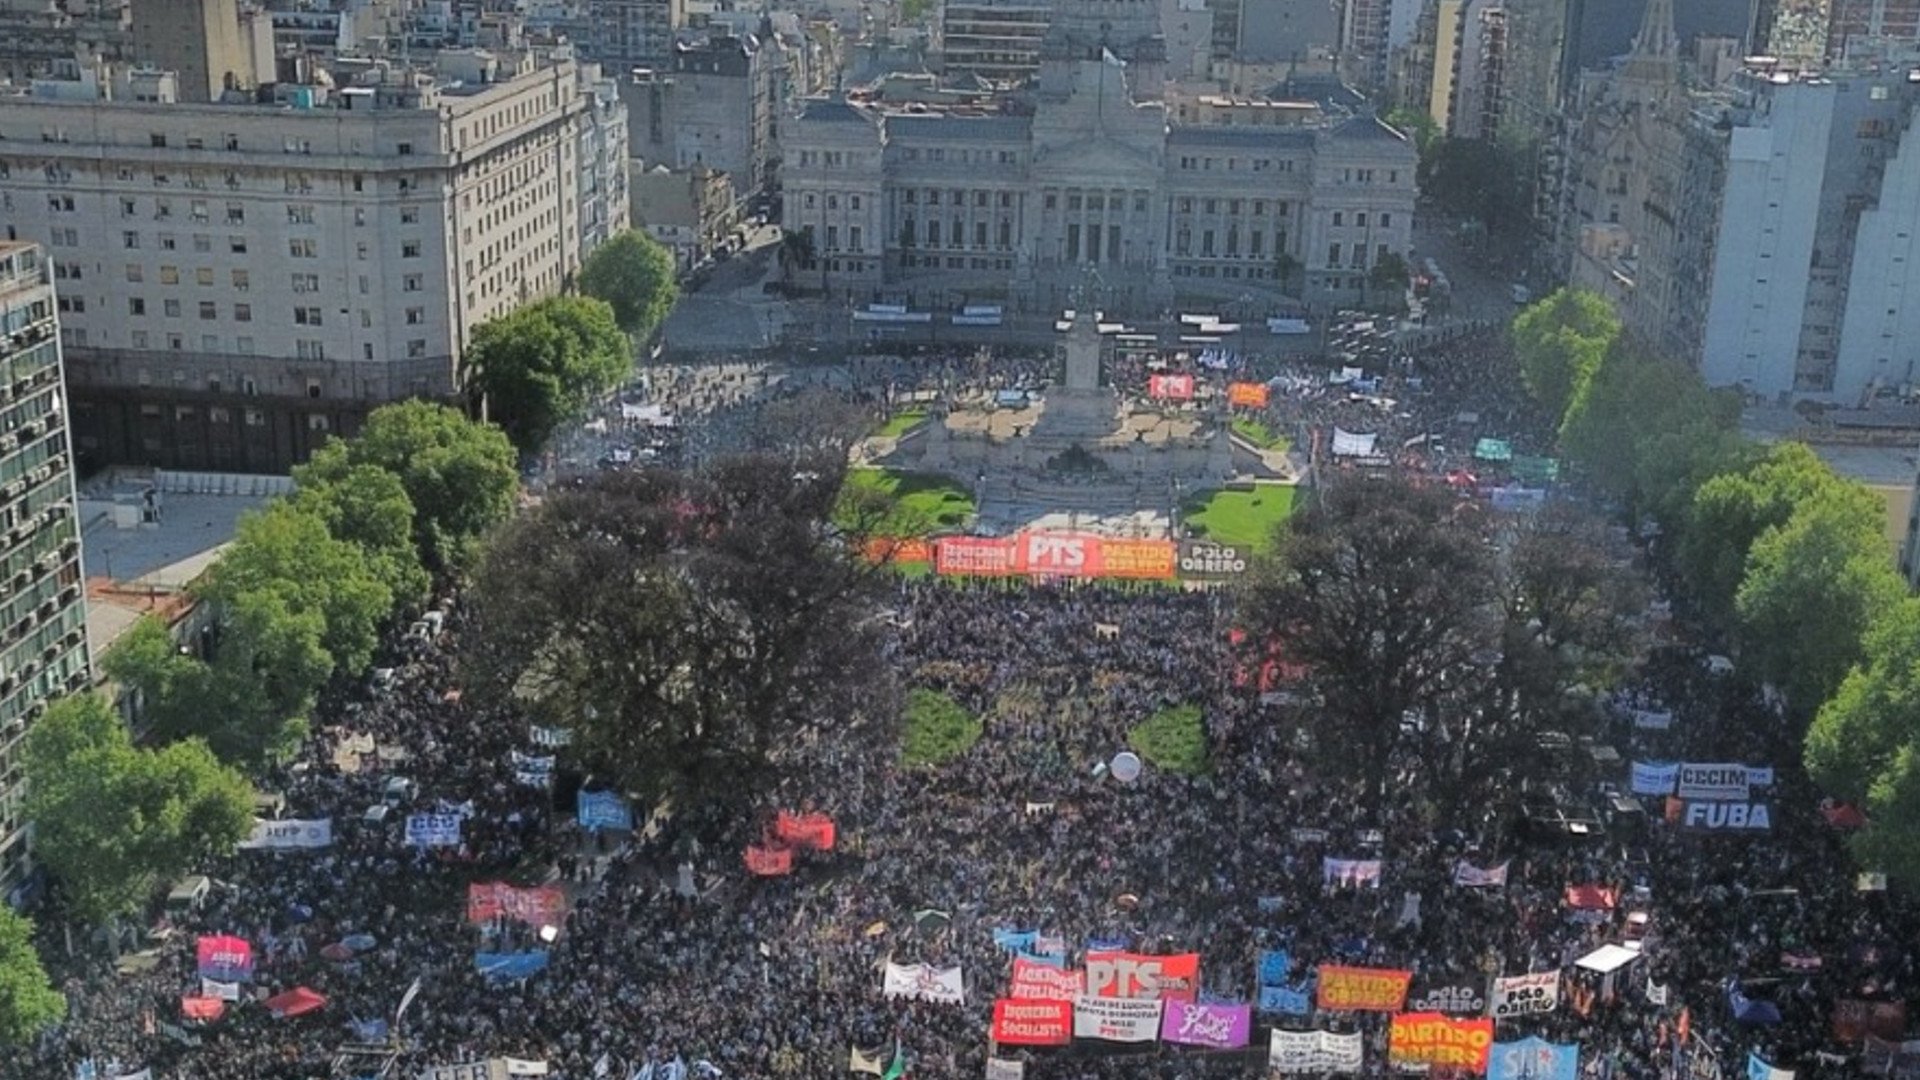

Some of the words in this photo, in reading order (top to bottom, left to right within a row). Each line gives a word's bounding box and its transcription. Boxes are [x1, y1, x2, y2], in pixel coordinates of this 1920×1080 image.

[1029, 536, 1084, 566] PTS
[1102, 545, 1172, 558] PARTIDO
[1192, 546, 1235, 559] POLO
[1181, 558, 1246, 572] OBRERO
[1682, 767, 1747, 786] CECIM
[1685, 802, 1770, 829] FUBA
[1087, 957, 1163, 1000] PTS
[1321, 971, 1406, 991] PARTIDO
[1325, 988, 1400, 1004] OBRERO
[1428, 985, 1475, 1000] POLO
[1507, 986, 1544, 1003] POLO
[1415, 998, 1484, 1012] OBRERO
[1390, 1019, 1490, 1048] PARTIDO
